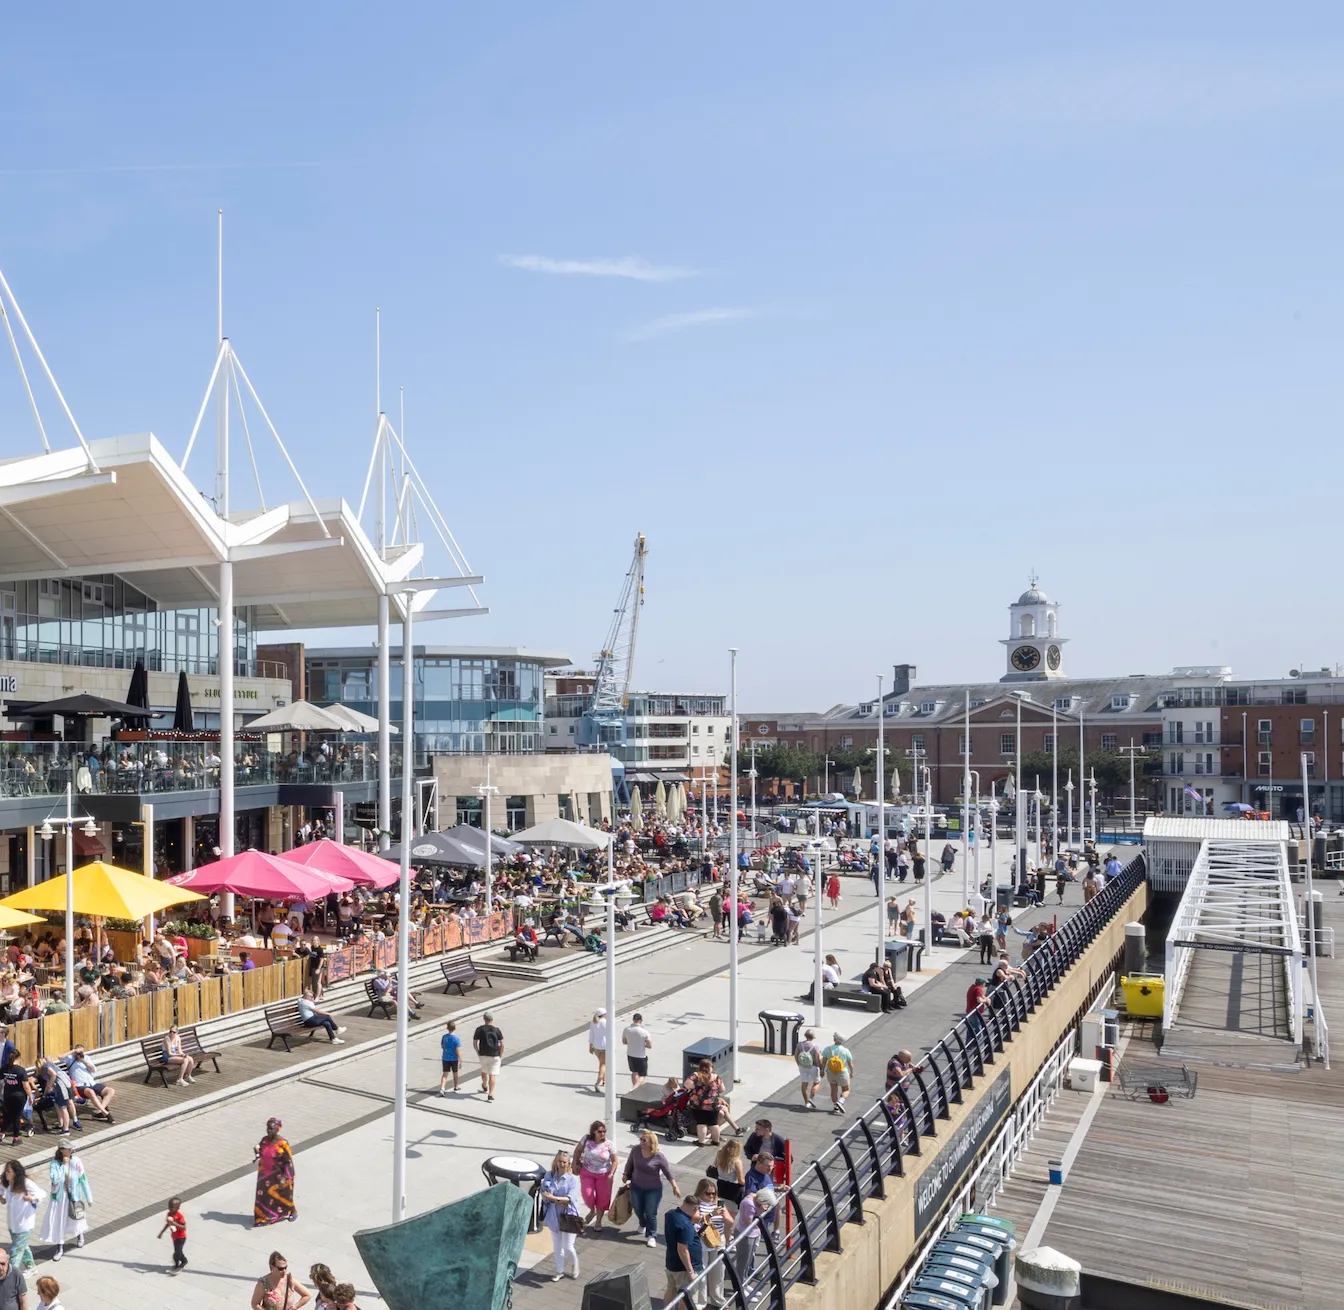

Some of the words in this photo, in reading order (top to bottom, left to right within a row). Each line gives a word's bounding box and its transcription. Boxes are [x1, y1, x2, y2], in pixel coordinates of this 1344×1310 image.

[1255, 783, 1284, 792] MUSTO
[918, 1174, 943, 1216] WELCOME
[941, 1164, 949, 1183] TO
[948, 1133, 971, 1173] GUNWHARF
[970, 1119, 983, 1144] QUAYS
